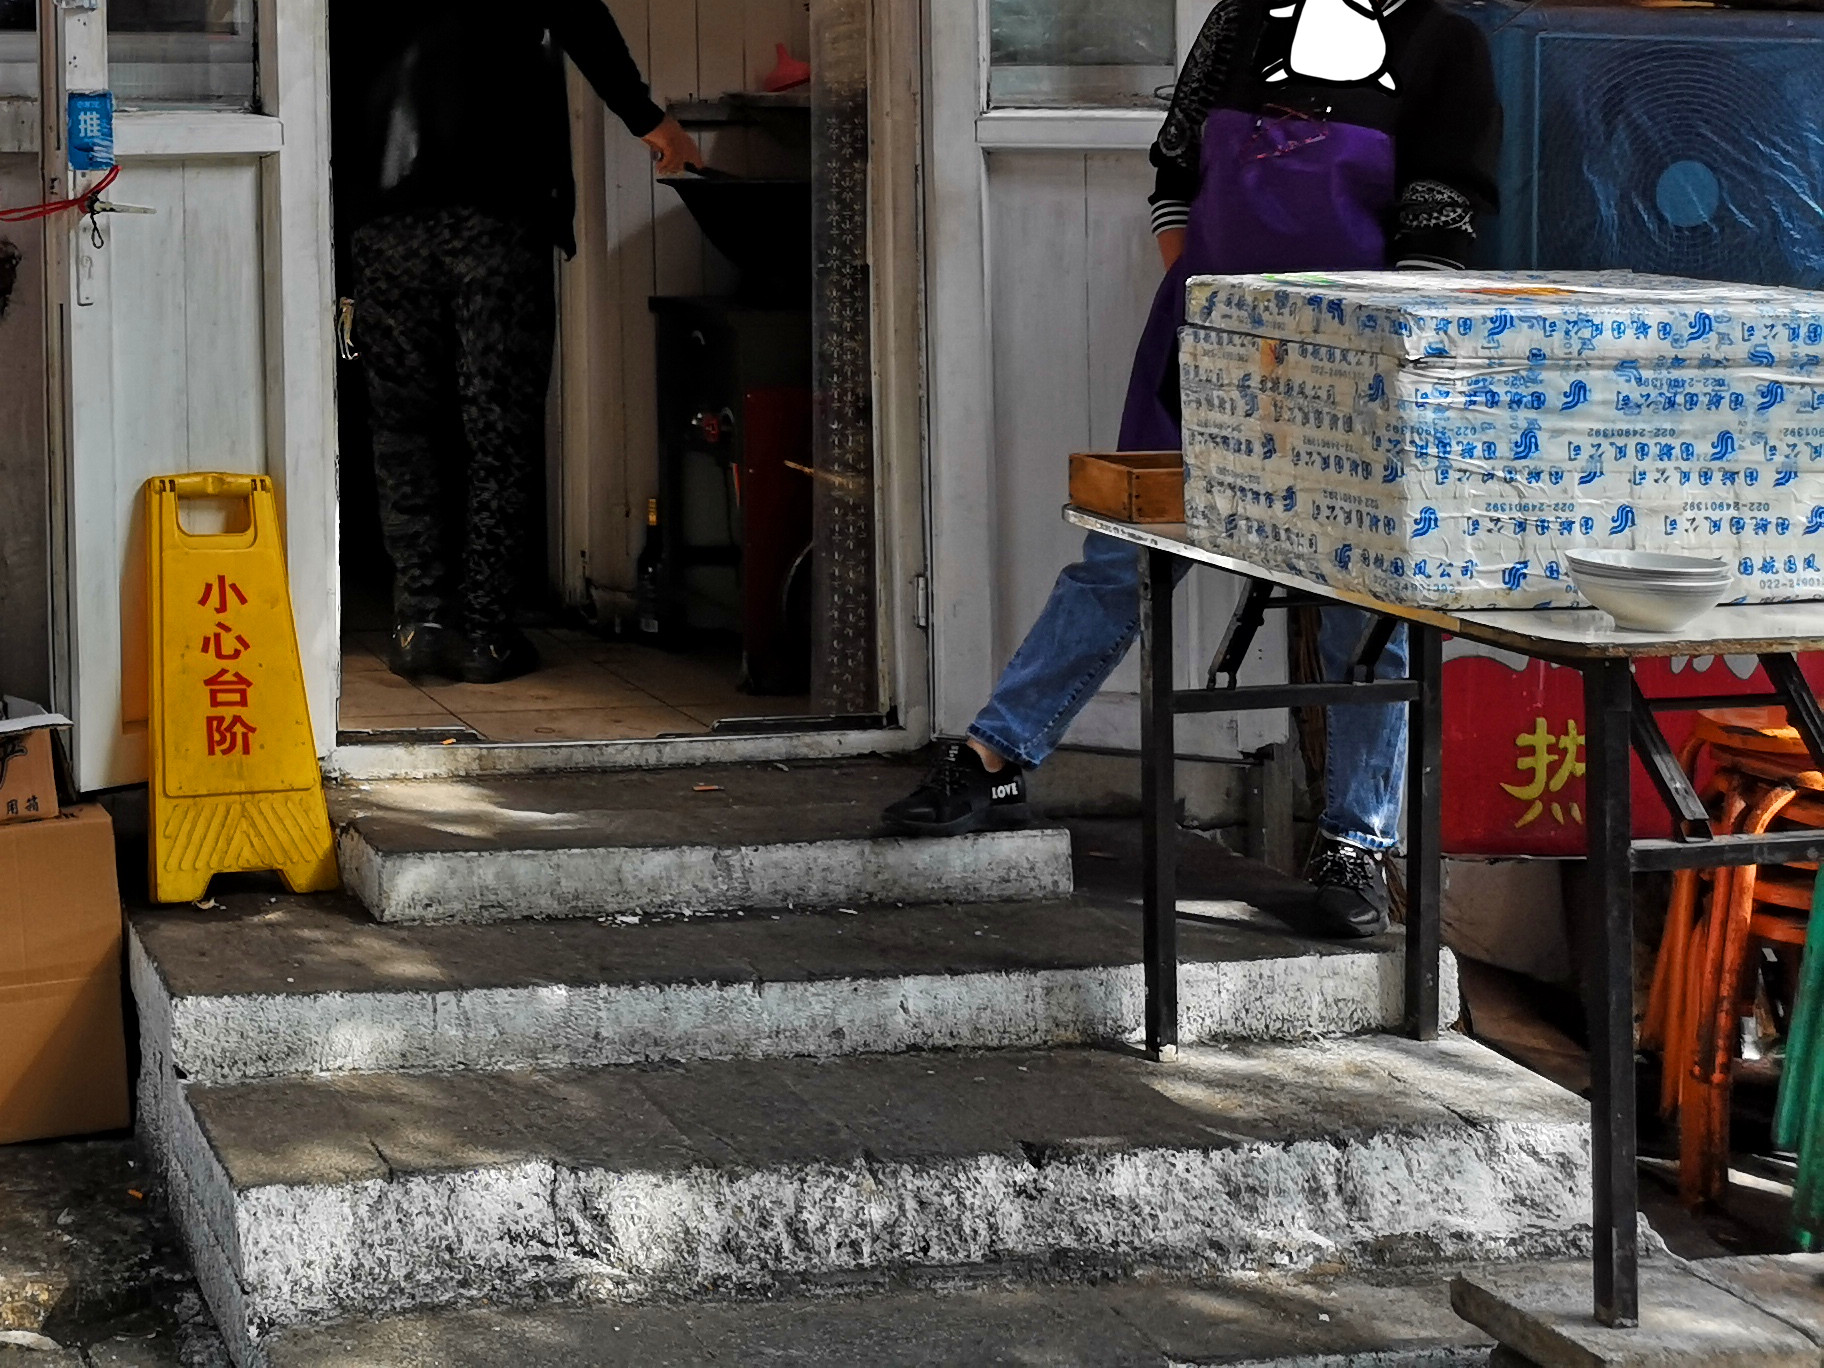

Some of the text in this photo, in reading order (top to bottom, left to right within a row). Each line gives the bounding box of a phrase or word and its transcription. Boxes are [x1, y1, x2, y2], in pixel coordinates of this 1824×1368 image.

[77, 111, 101, 138] 推
[196, 574, 257, 757] 小心台阶
[991, 782, 1019, 800] LOVE
